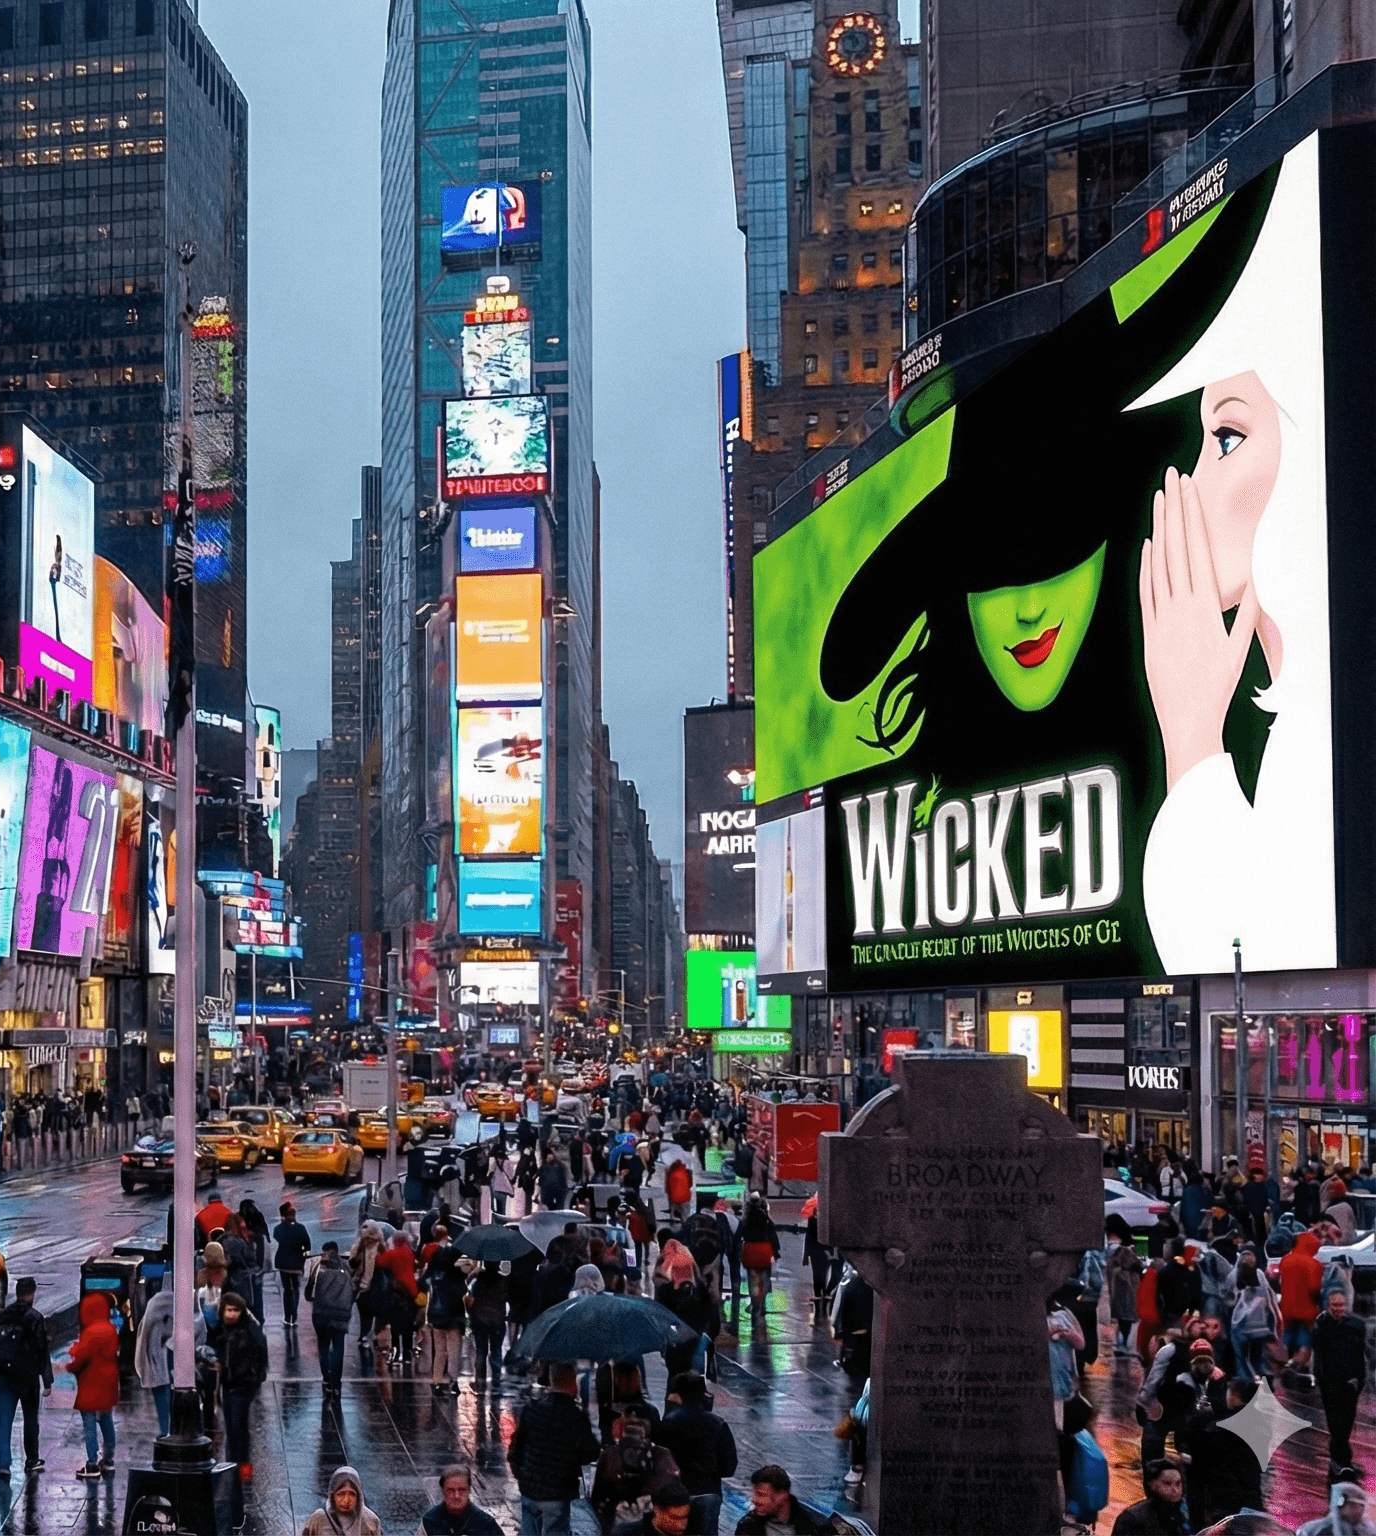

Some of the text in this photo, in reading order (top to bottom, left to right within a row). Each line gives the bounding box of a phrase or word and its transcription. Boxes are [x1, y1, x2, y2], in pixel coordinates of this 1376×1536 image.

[851, 945, 872, 965] THE
[962, 936, 977, 955] OF
[1073, 924, 1093, 946] OF
[887, 1163, 1046, 1188] BROADWAY
